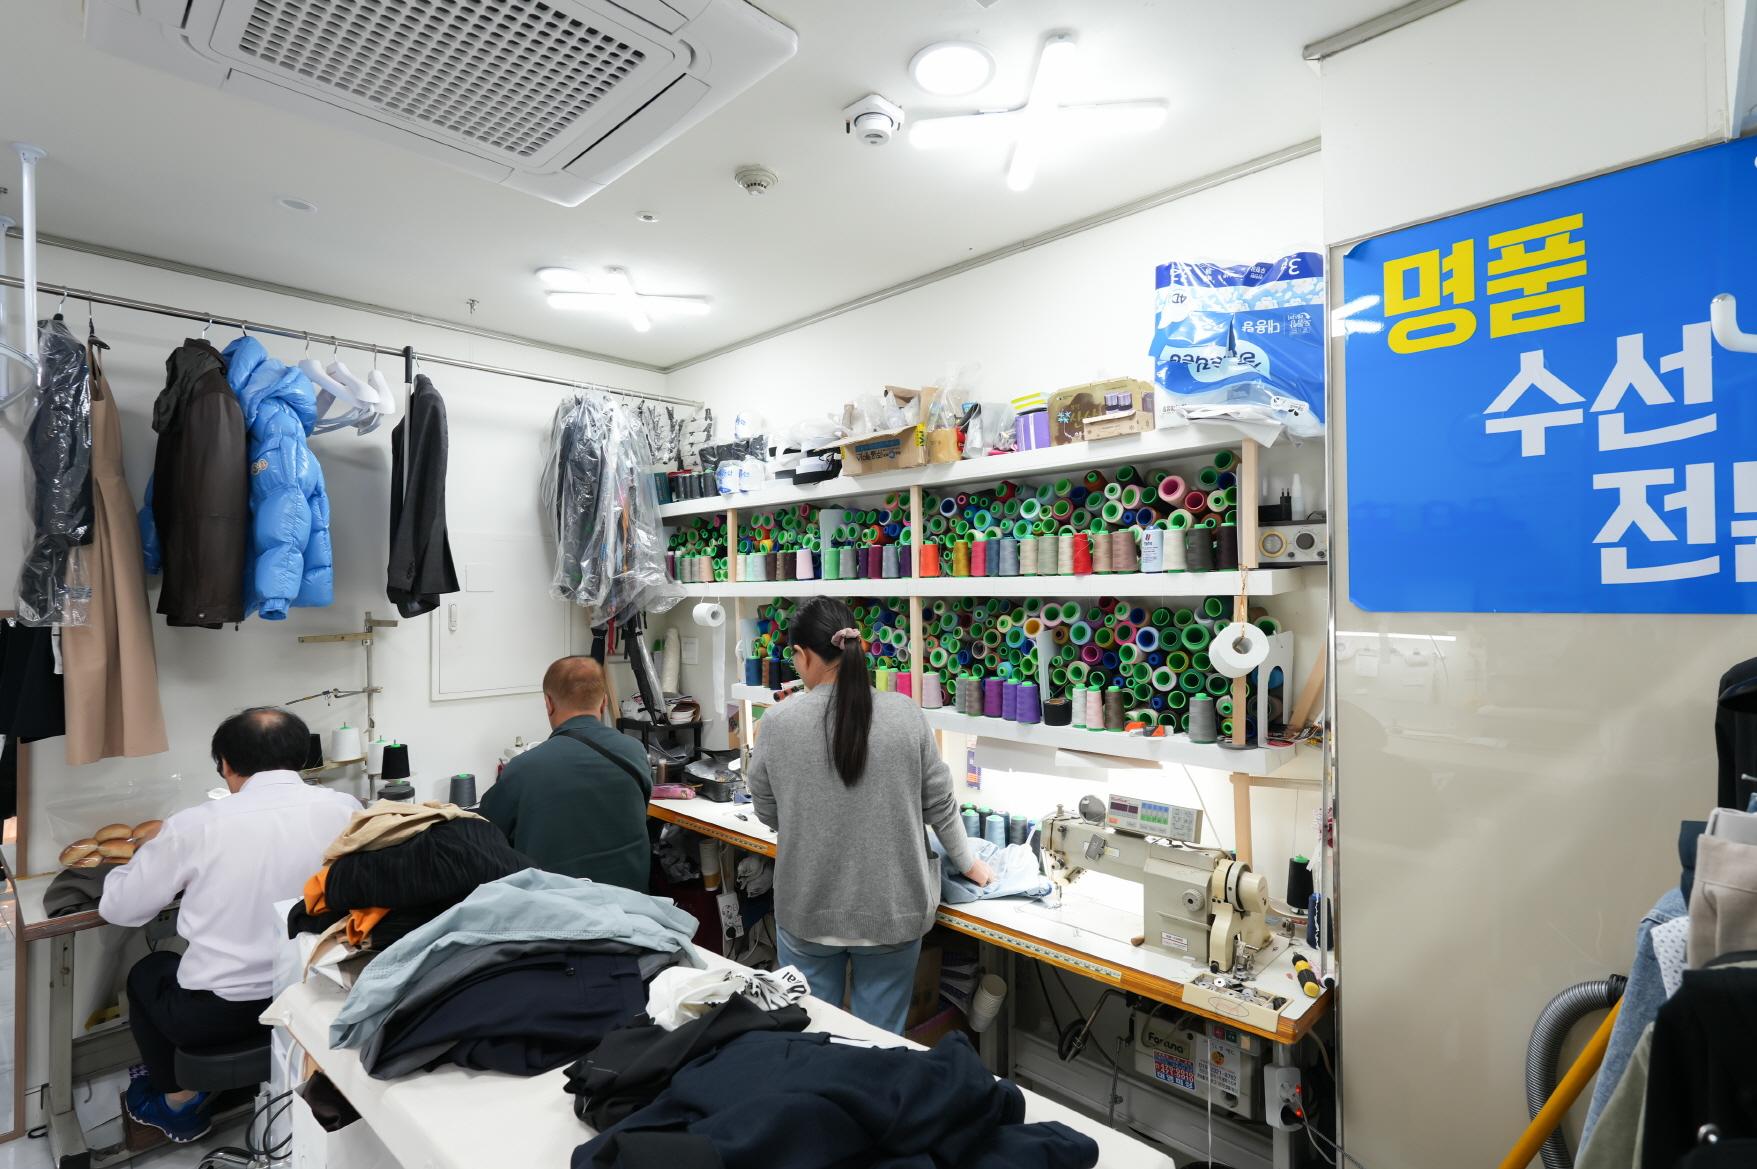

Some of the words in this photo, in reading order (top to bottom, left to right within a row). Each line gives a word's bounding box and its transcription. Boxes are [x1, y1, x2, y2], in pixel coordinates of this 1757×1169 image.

[1241, 319, 1280, 335] 대용량
[1383, 212, 1587, 355] 명품
[1482, 320, 1717, 458] 수선
